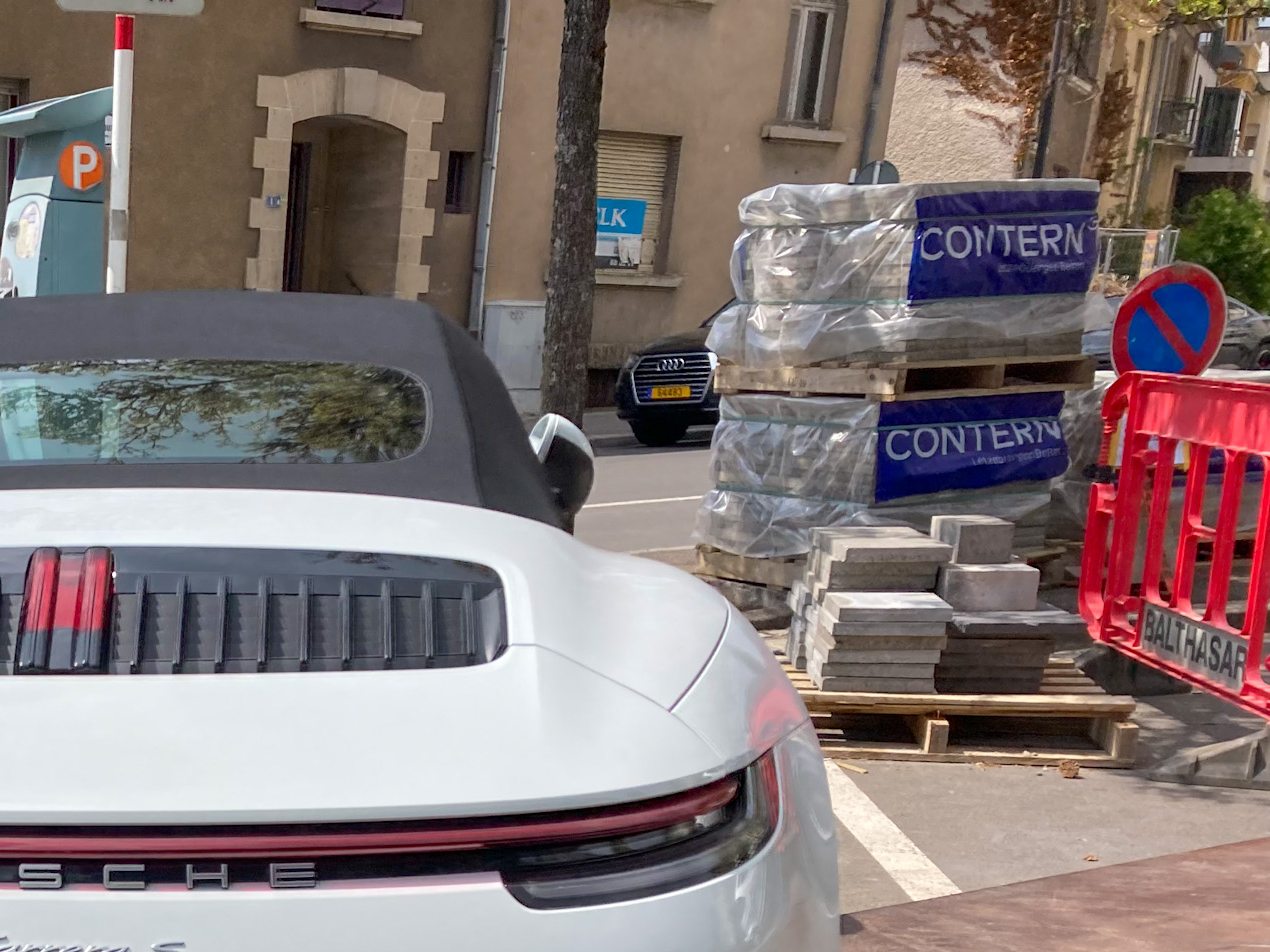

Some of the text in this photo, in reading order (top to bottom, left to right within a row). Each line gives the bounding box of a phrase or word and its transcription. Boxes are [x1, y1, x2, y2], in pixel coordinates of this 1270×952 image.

[73, 145, 98, 189] P
[596, 207, 627, 227] LK
[920, 222, 1085, 261] CONTERN
[886, 421, 1062, 461] CONTERN
[1143, 608, 1247, 679] BALTHASAR
